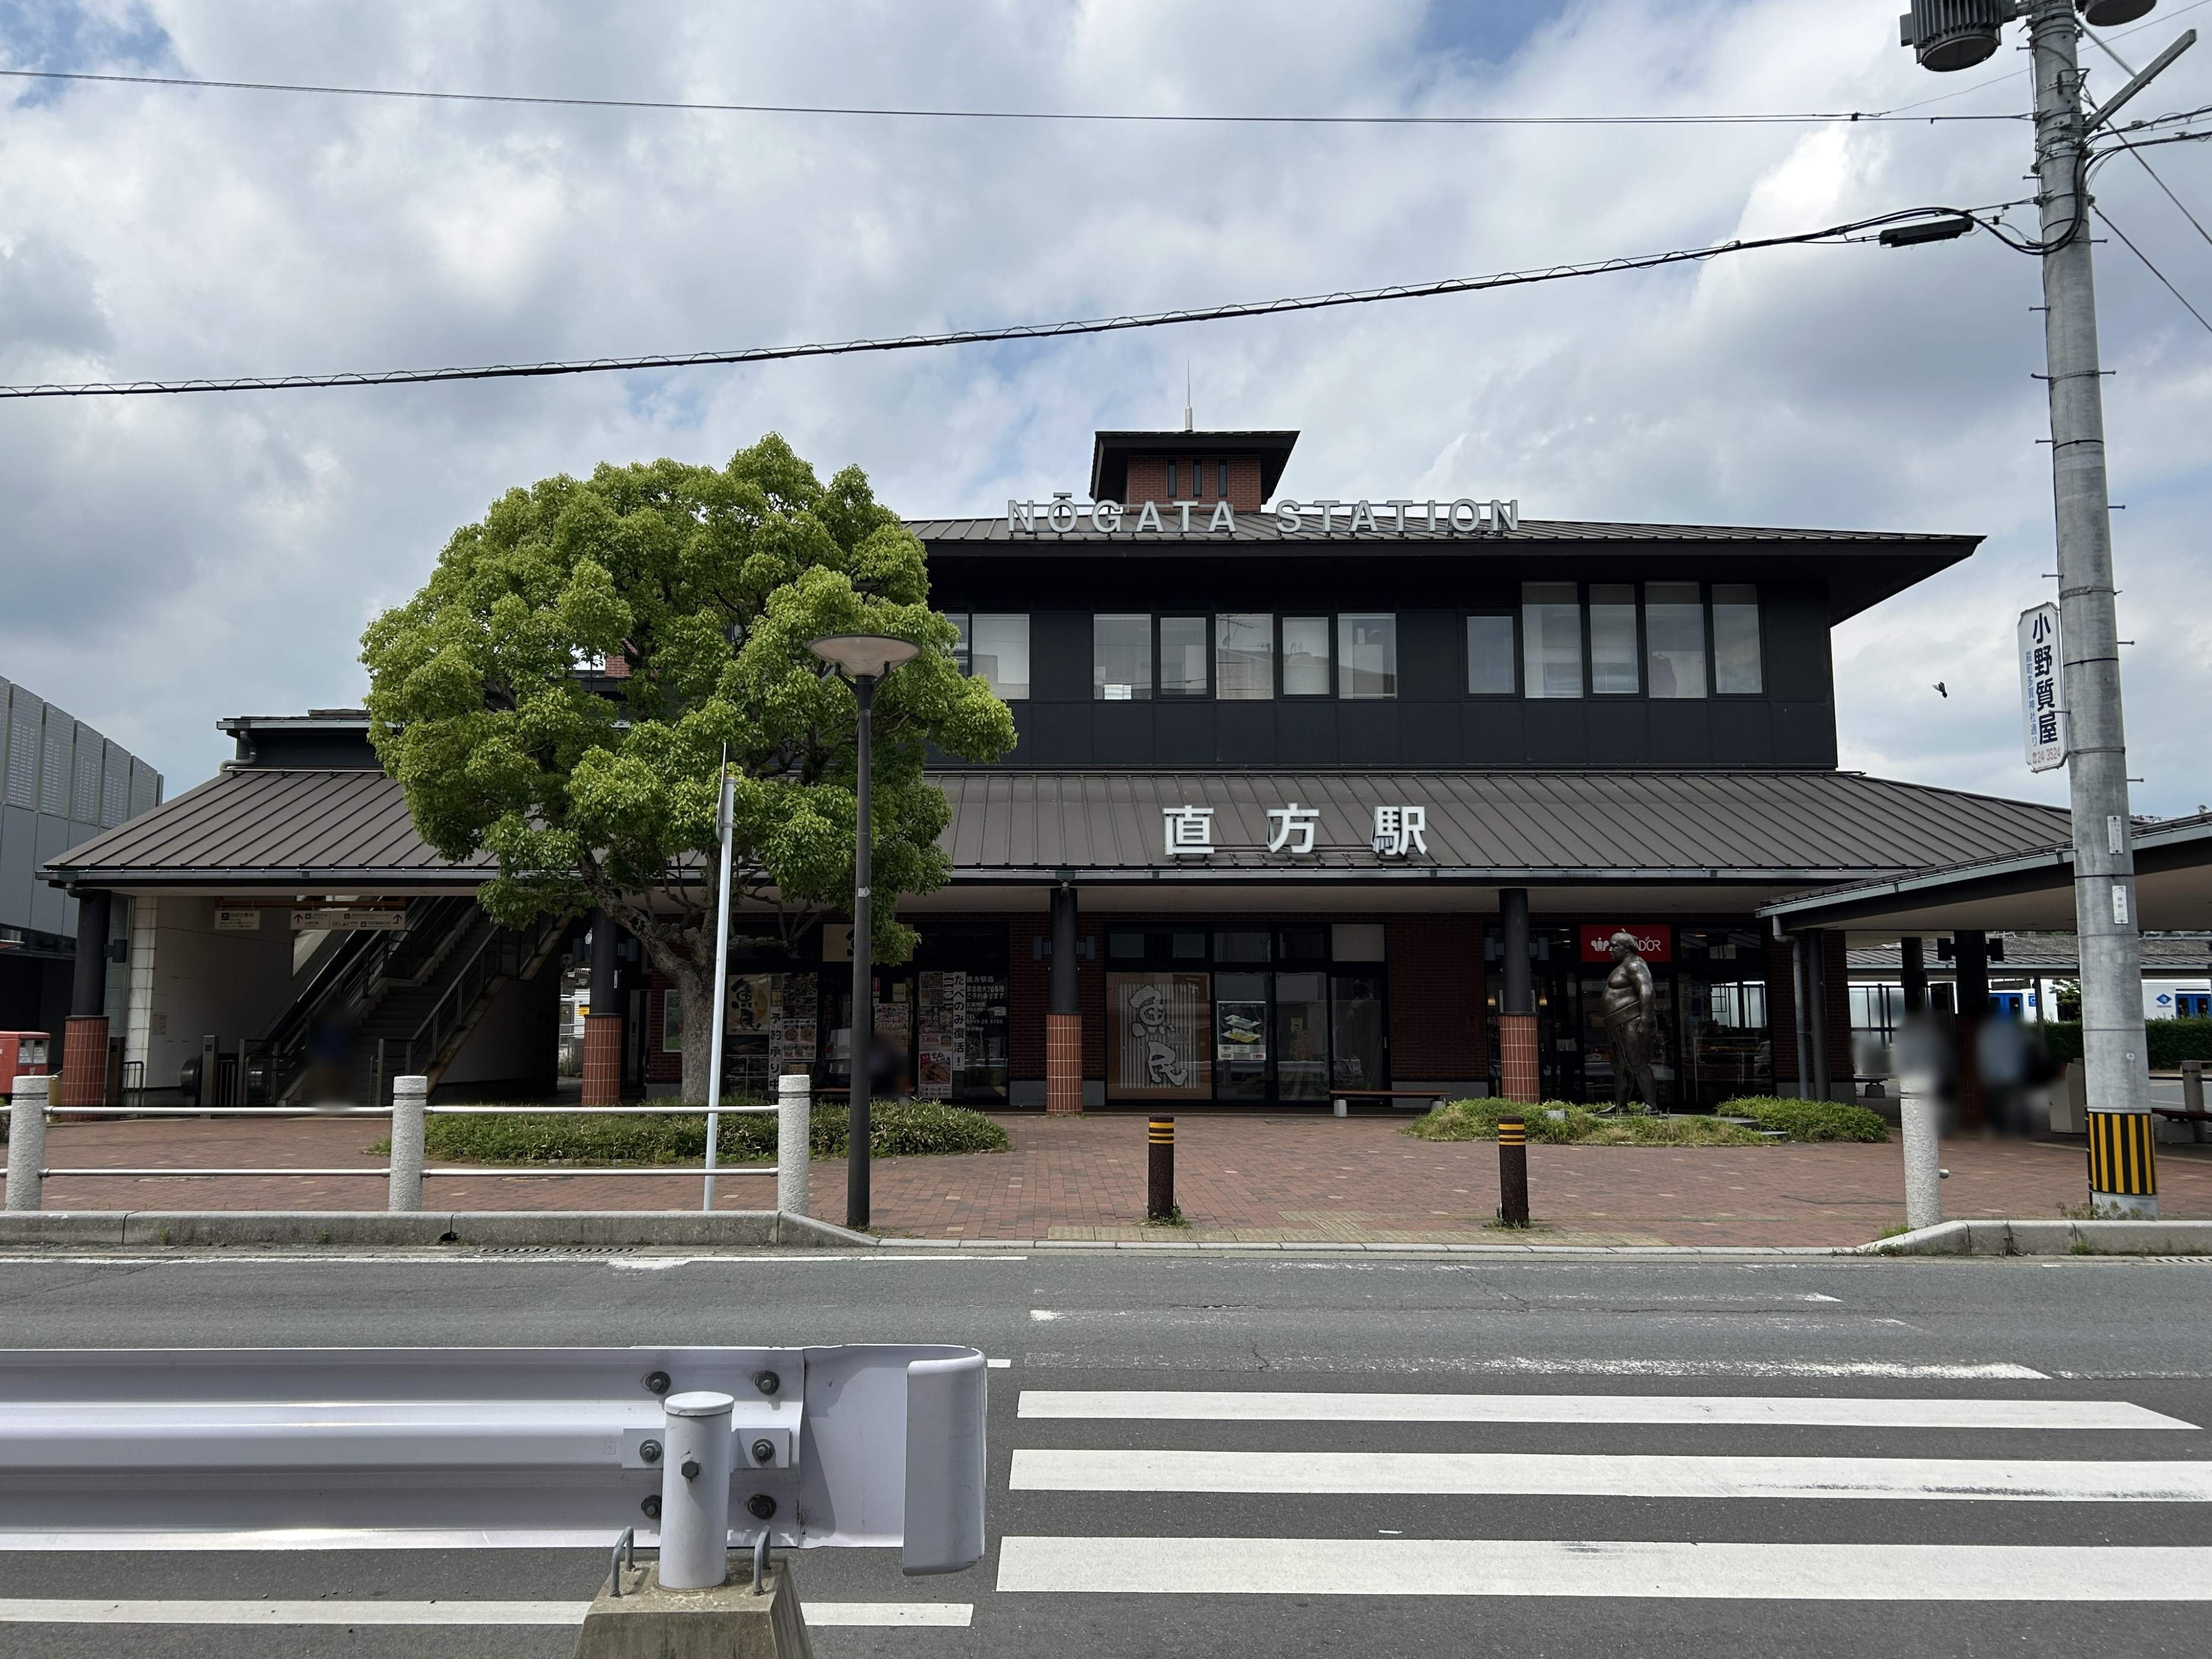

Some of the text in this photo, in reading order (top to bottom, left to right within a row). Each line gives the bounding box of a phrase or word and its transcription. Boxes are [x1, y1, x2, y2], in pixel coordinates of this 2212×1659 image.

[1008, 492, 1518, 534] NŌGATA STATION
[2032, 612, 2058, 745] 小野質屋
[1162, 802, 1427, 856] 直方駅
[770, 1012, 782, 1090] 予約承り中
